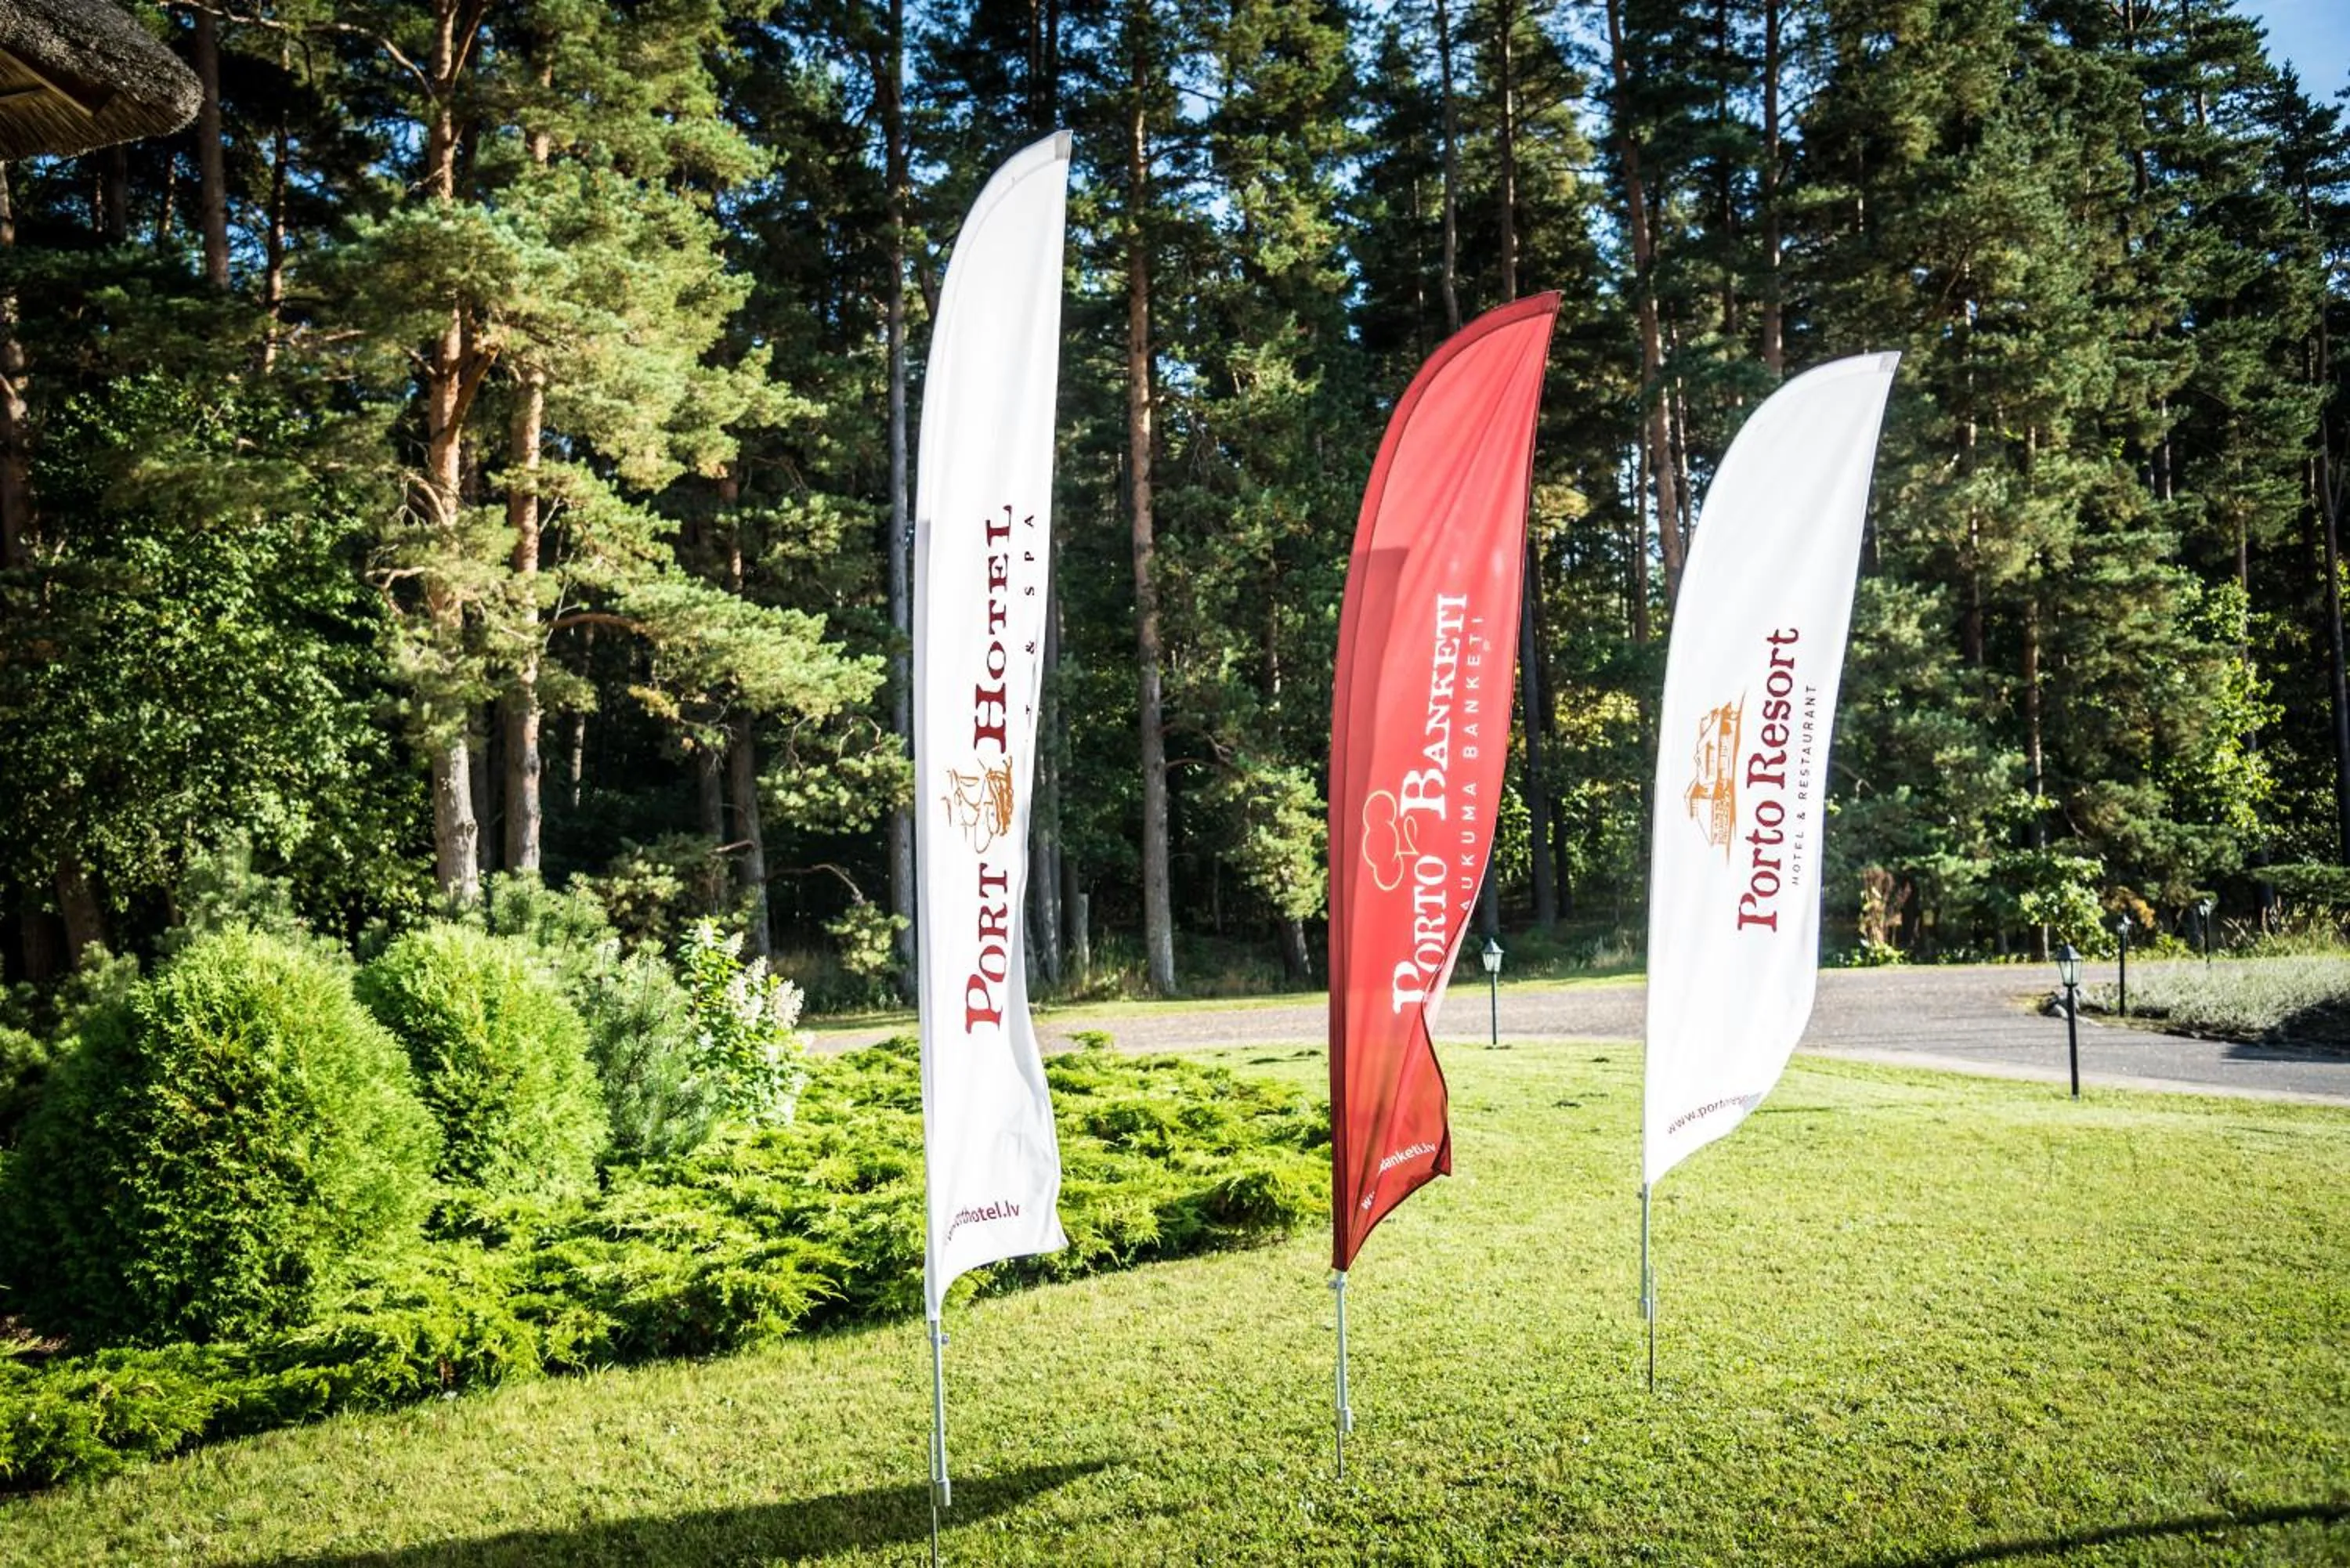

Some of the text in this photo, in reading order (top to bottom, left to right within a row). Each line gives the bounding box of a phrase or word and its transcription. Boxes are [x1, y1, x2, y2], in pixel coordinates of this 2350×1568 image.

[1024, 515, 1036, 655] & SPA
[965, 505, 1012, 1034] PORT HOTEL
[1392, 594, 1467, 1014] PORTO BANKETI
[1460, 617, 1484, 911] AUKUMA BANKETI
[1737, 627, 1799, 933] Porto Resort
[1791, 685, 1817, 886] HOTEL & RESTAURANT
